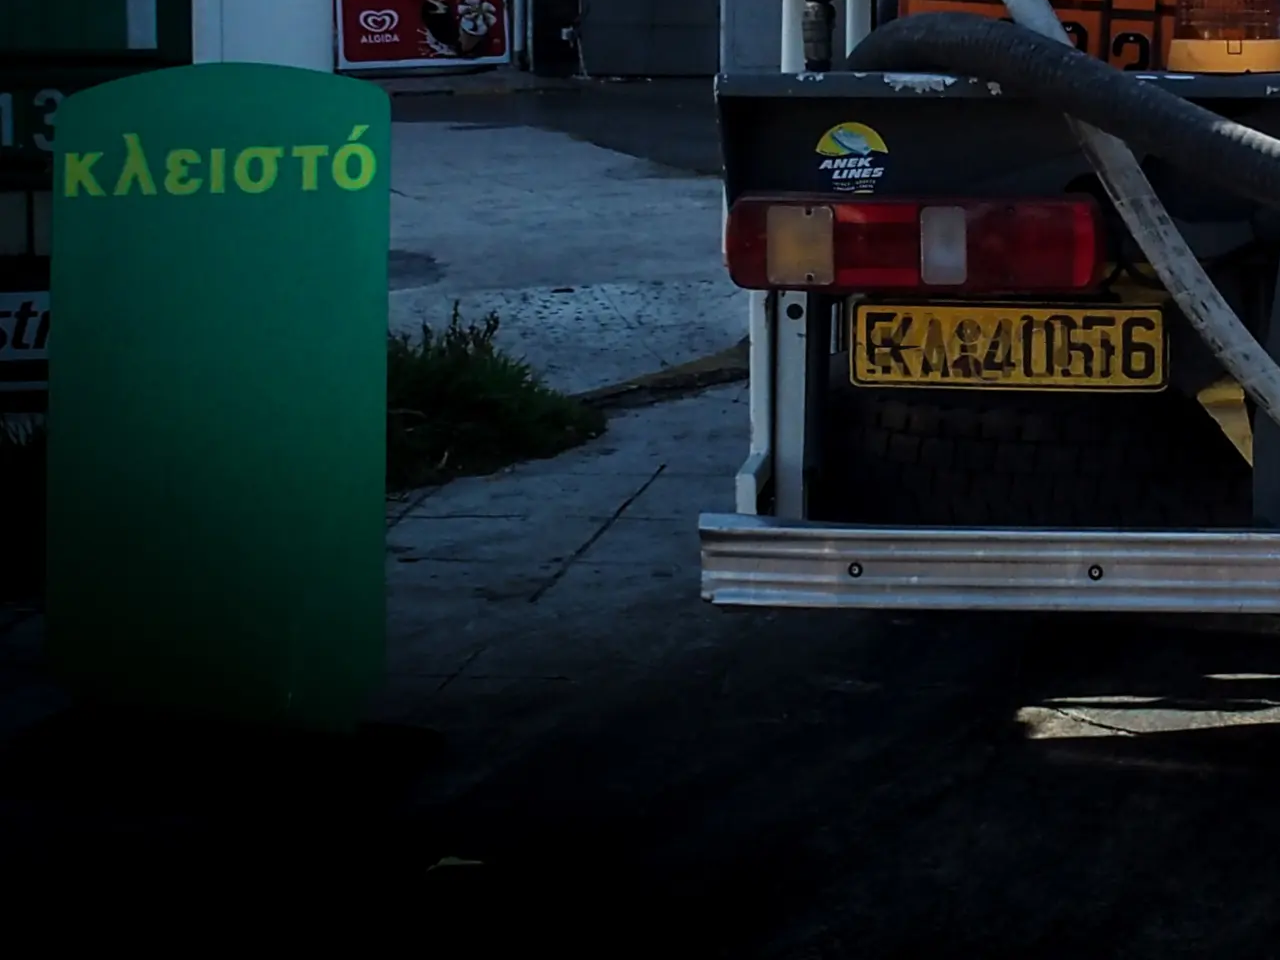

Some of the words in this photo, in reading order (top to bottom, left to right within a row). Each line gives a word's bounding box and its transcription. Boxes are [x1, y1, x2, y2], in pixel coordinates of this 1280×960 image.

[360, 33, 400, 44] ALGIDA
[63, 124, 377, 198] κλειστό
[819, 156, 875, 170] ANEK
[832, 166, 885, 179] LINES
